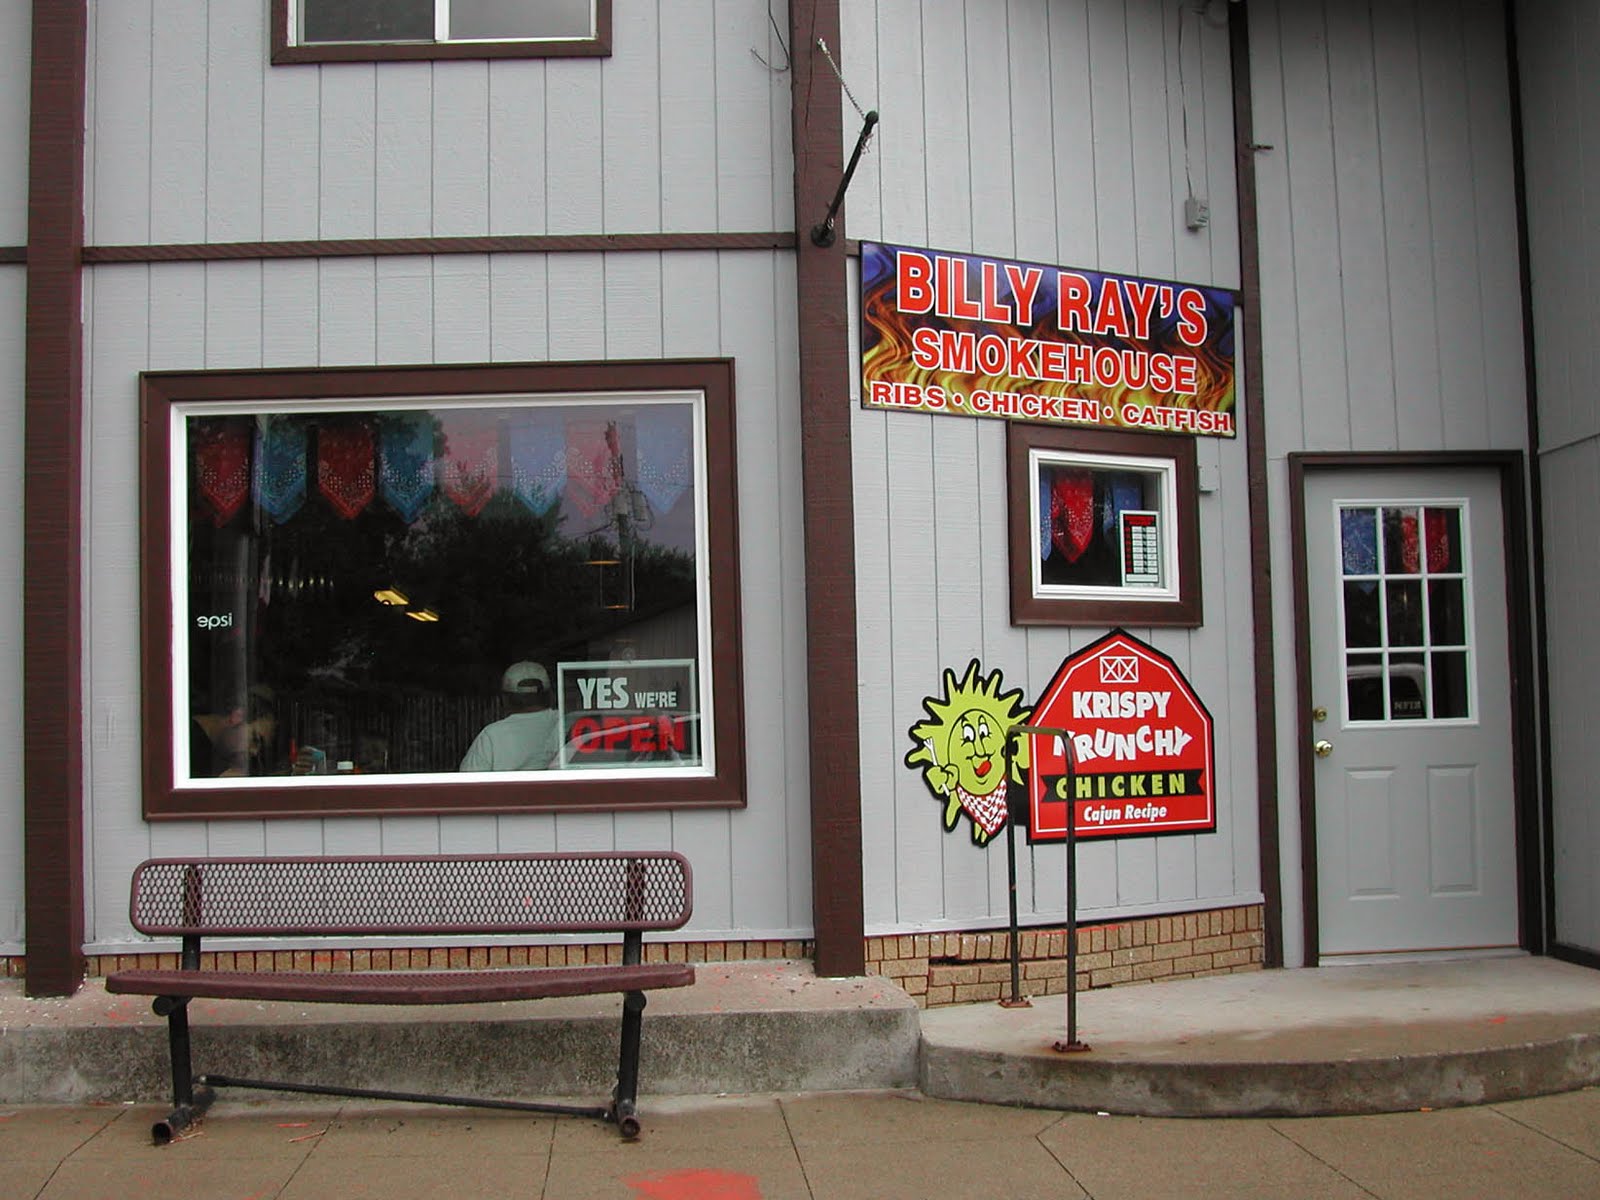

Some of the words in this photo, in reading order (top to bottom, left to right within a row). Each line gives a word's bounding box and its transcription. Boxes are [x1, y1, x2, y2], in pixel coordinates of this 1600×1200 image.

[897, 251, 1042, 326] BILLY
[1058, 271, 1207, 346] RAY'S
[912, 327, 1197, 395] SMOKEHOUSE
[871, 381, 946, 408] RIBS
[970, 390, 1100, 422] CHICKEN
[1120, 404, 1231, 432] CATFISH
[577, 677, 629, 709] YES
[634, 691, 677, 708] WE'RE
[1072, 691, 1171, 719] KRISPY
[571, 715, 685, 754] OPEN
[1056, 773, 1187, 799] CHICKEN
[1084, 805, 1121, 825] Cajun
[1125, 802, 1167, 822] Recipe
